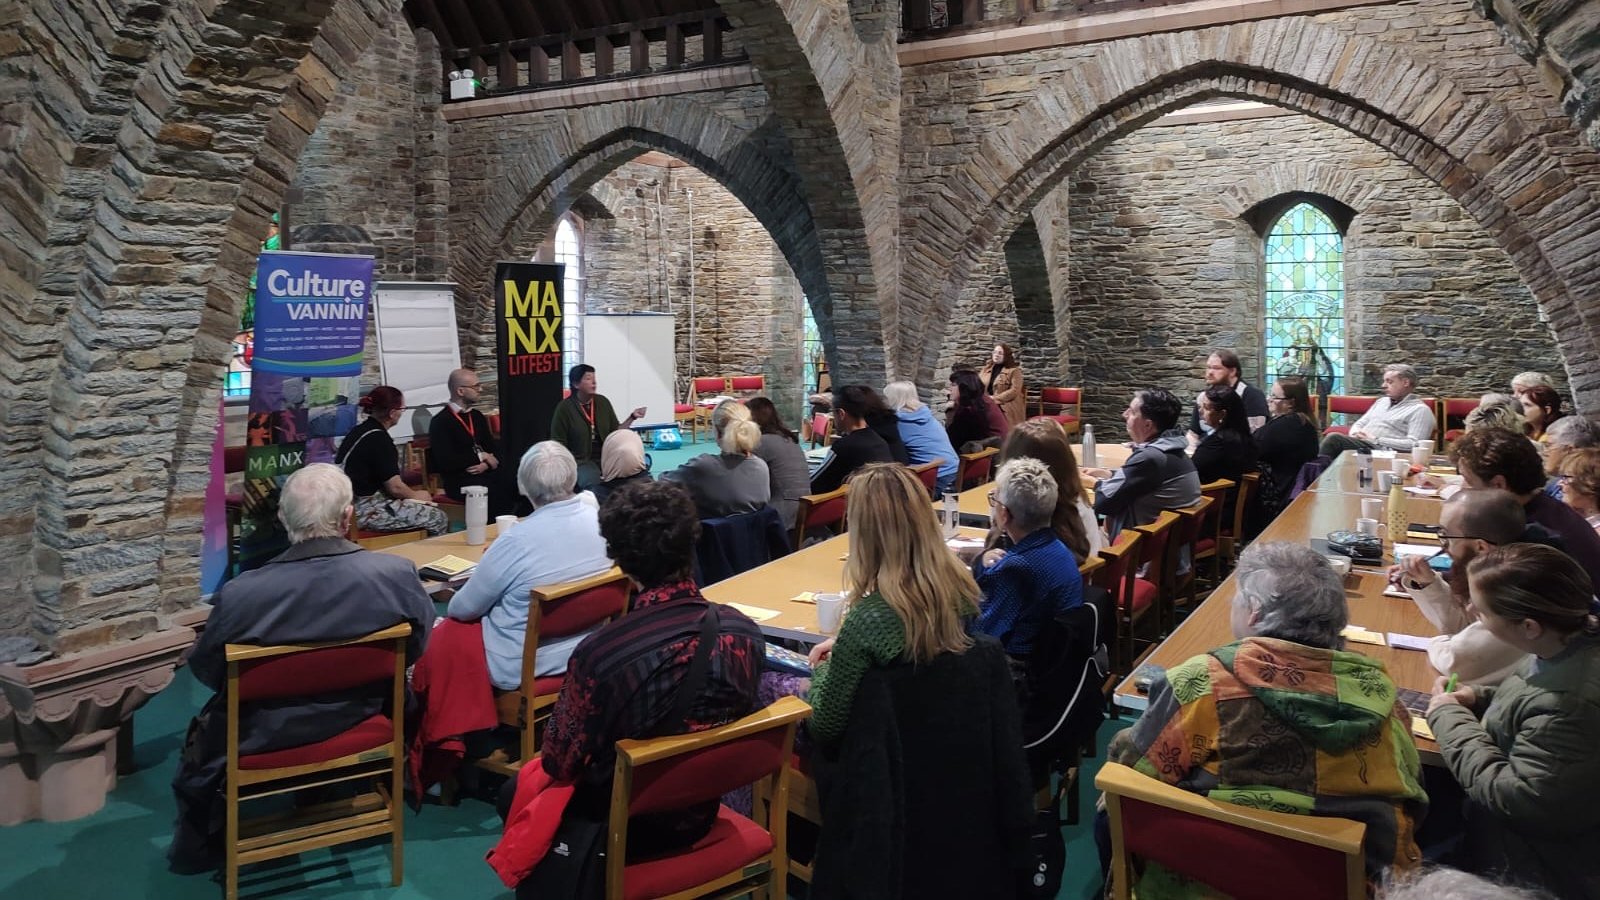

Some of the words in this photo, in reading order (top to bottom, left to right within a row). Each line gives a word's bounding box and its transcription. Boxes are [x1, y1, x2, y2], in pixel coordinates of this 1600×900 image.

[267, 268, 366, 297] Culture
[503, 280, 562, 317] MA
[505, 317, 561, 355] NX
[508, 353, 561, 376] LITFEST
[249, 450, 304, 472] MANX
